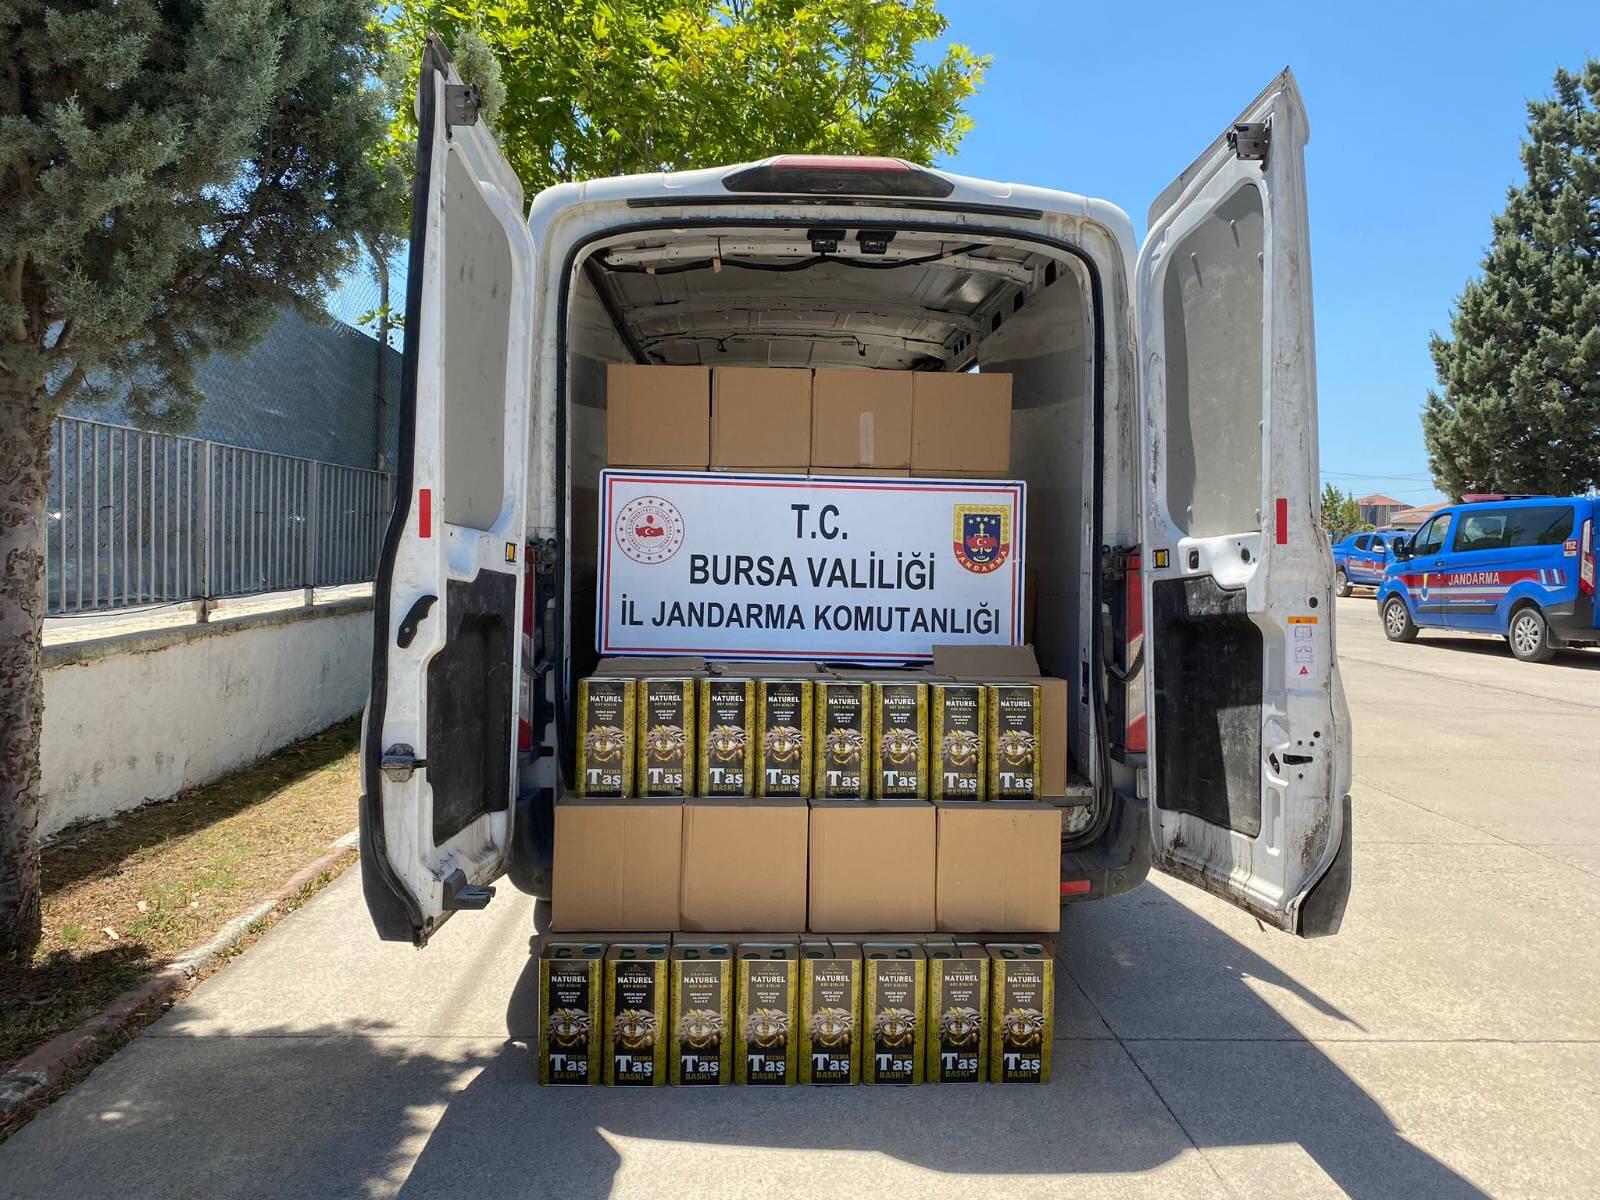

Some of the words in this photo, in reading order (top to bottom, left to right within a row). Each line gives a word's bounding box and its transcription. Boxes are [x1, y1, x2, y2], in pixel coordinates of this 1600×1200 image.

[791, 504, 848, 540] T.C.
[690, 554, 797, 587] BURSA
[807, 551, 935, 590] VALİLİĞİ
[956, 550, 1007, 572] JANDARMA
[1448, 572, 1500, 586] JANDARMA
[621, 594, 643, 626] İL
[652, 601, 805, 630] JANDARMA
[815, 602, 999, 634] KOMUTANLIĞI
[587, 769, 621, 788] Taş
[649, 768, 682, 788] Taş
[710, 768, 743, 788] Taş
[766, 769, 799, 788] Taş
[827, 771, 860, 790] Taş
[883, 771, 917, 790] Taş
[944, 773, 977, 792] Taş
[1000, 773, 1033, 792] Taş
[550, 1054, 587, 1075] Taş
[615, 1055, 653, 1076] Taş
[681, 1055, 719, 1076] Taş
[748, 1054, 785, 1075] Taş
[813, 1054, 849, 1074] Taş
[876, 1053, 913, 1074] Taş
[942, 1053, 978, 1073] Taş
[1004, 1053, 1040, 1074] Taş
